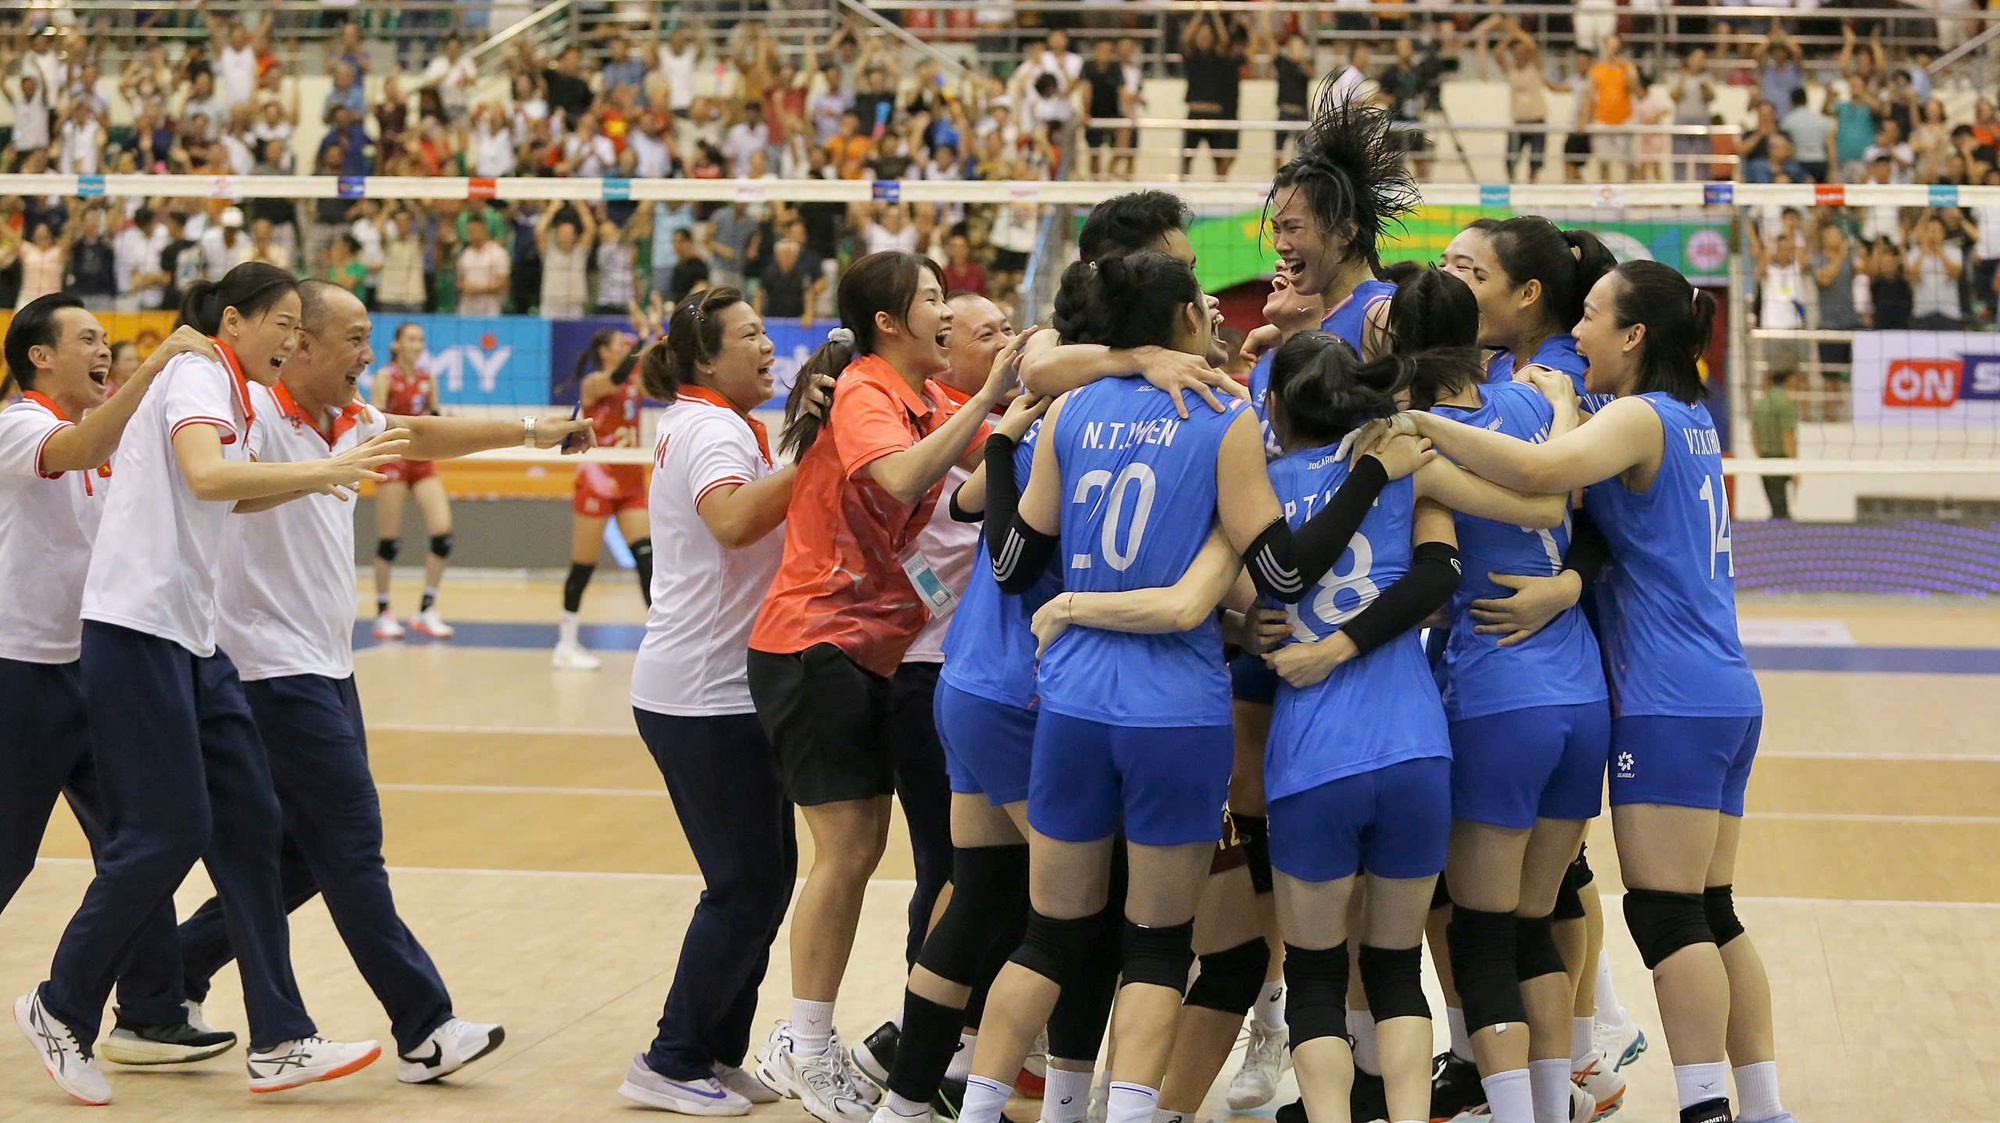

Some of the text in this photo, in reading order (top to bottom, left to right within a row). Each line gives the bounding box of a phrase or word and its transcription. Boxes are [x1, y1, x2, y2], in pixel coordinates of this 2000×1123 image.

[1891, 366, 1955, 402] ON
[1071, 462, 1156, 573] 20
[1699, 474, 1734, 580] 14
